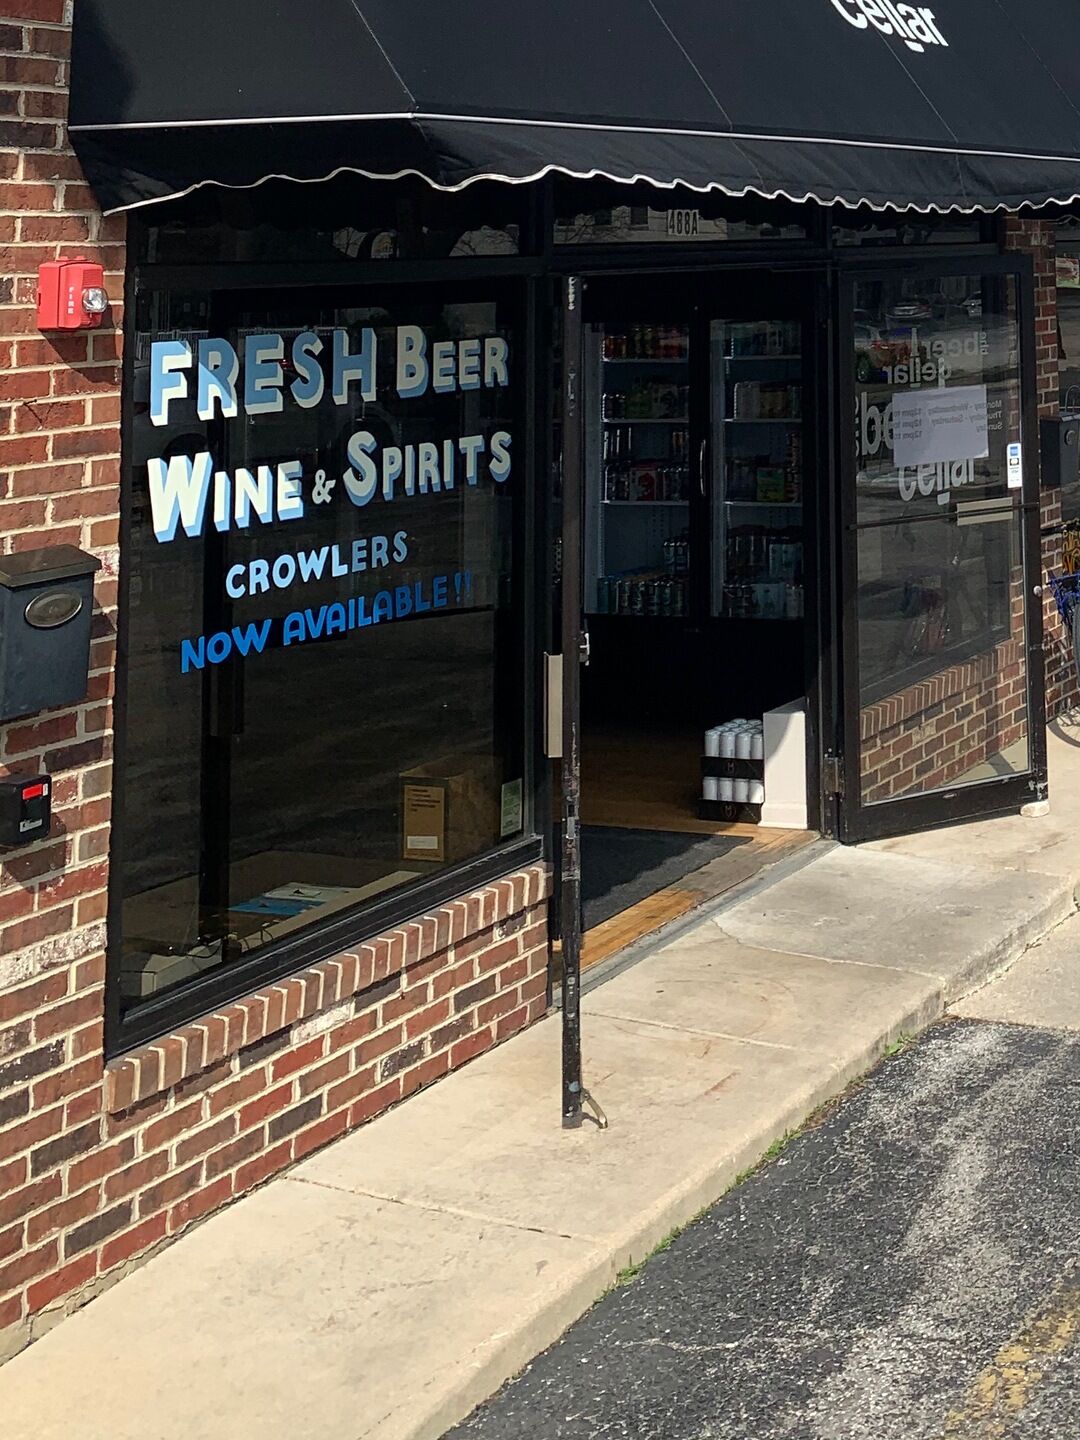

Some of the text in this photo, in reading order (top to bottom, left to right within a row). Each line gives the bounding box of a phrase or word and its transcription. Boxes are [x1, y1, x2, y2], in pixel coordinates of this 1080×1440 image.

[669, 210, 698, 235] 488A
[67, 286, 75, 315] FIRE
[150, 325, 509, 427] FRESH BEER
[147, 431, 512, 543] WINE & SPIRITS
[225, 530, 408, 599] CROWLERS
[180, 619, 272, 673] NOW
